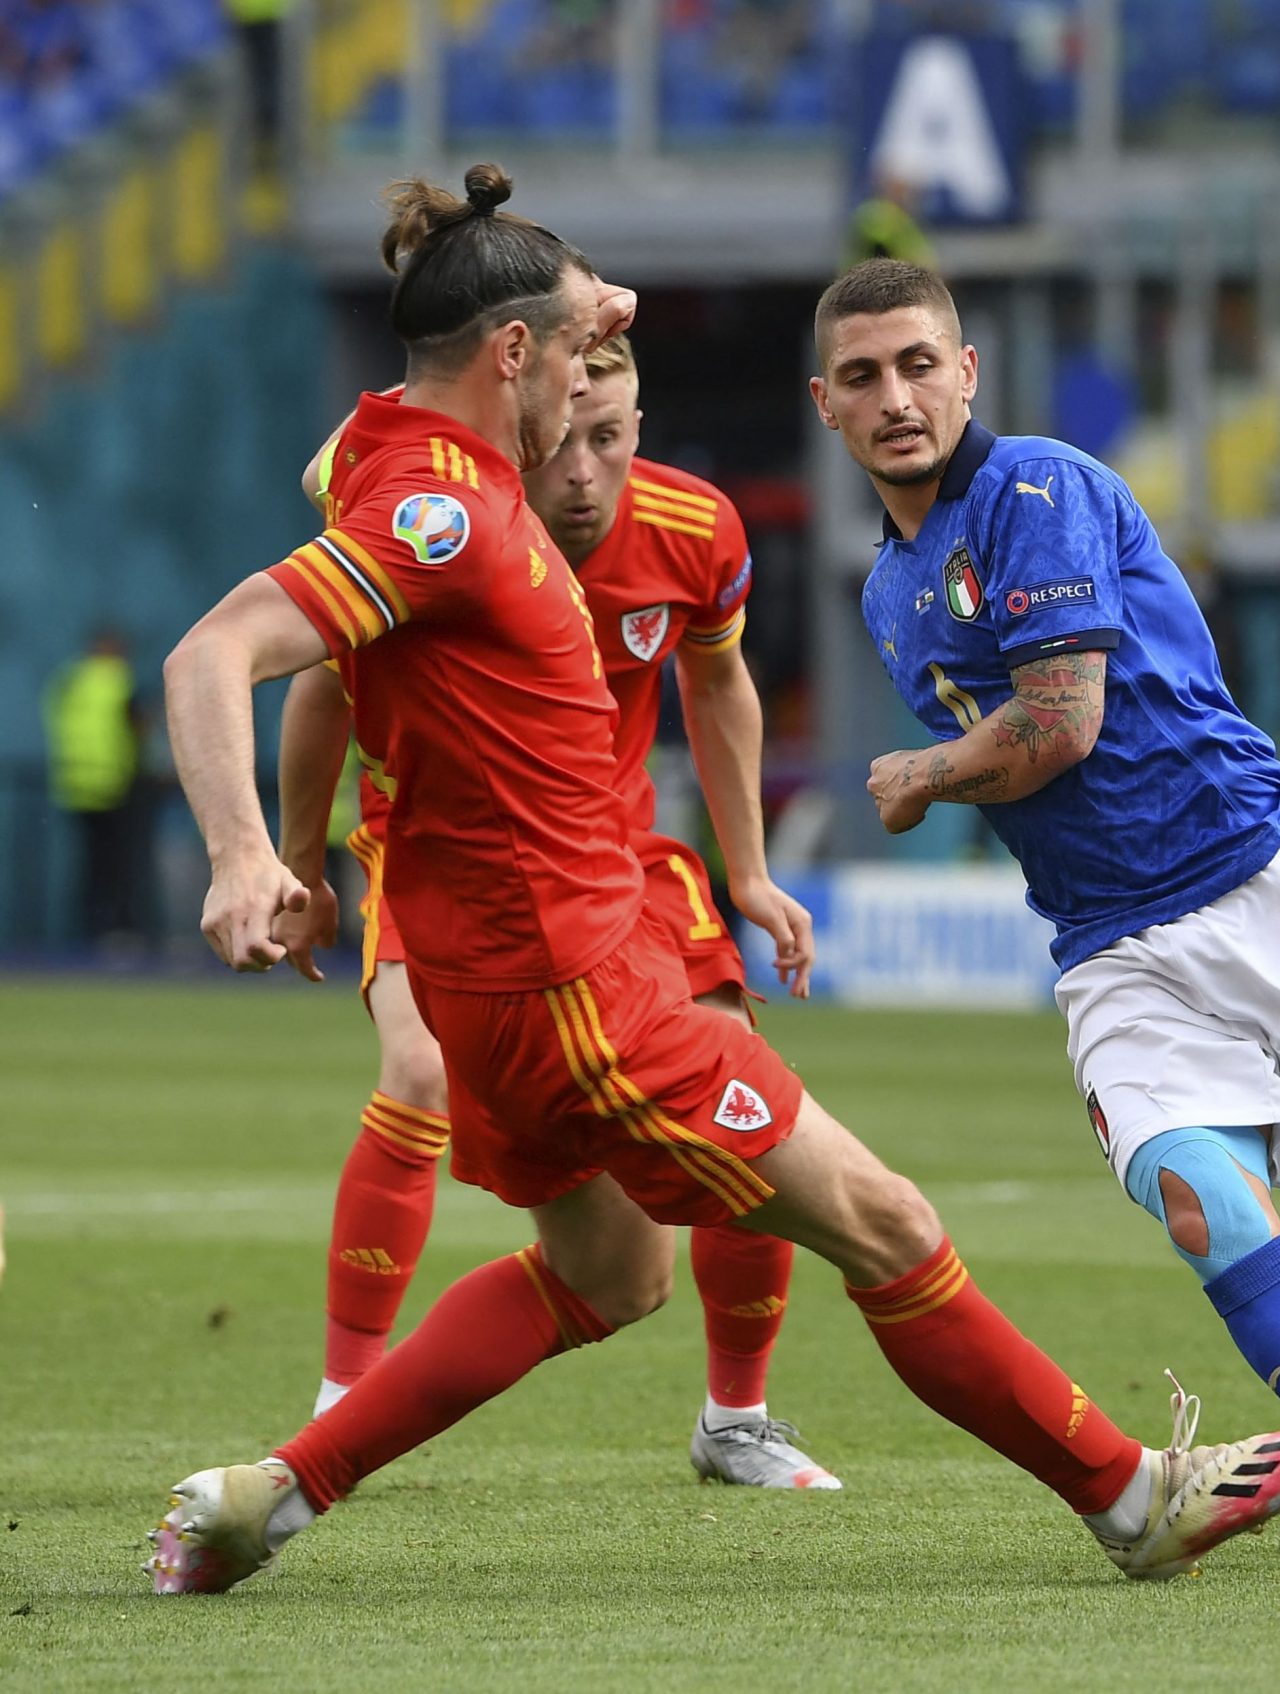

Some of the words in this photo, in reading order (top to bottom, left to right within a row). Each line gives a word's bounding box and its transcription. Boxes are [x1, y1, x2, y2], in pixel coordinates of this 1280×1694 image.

[868, 36, 1009, 218] A
[945, 551, 969, 577] ITALIA
[1030, 583, 1093, 605] RESPECT
[667, 854, 722, 941] 1
